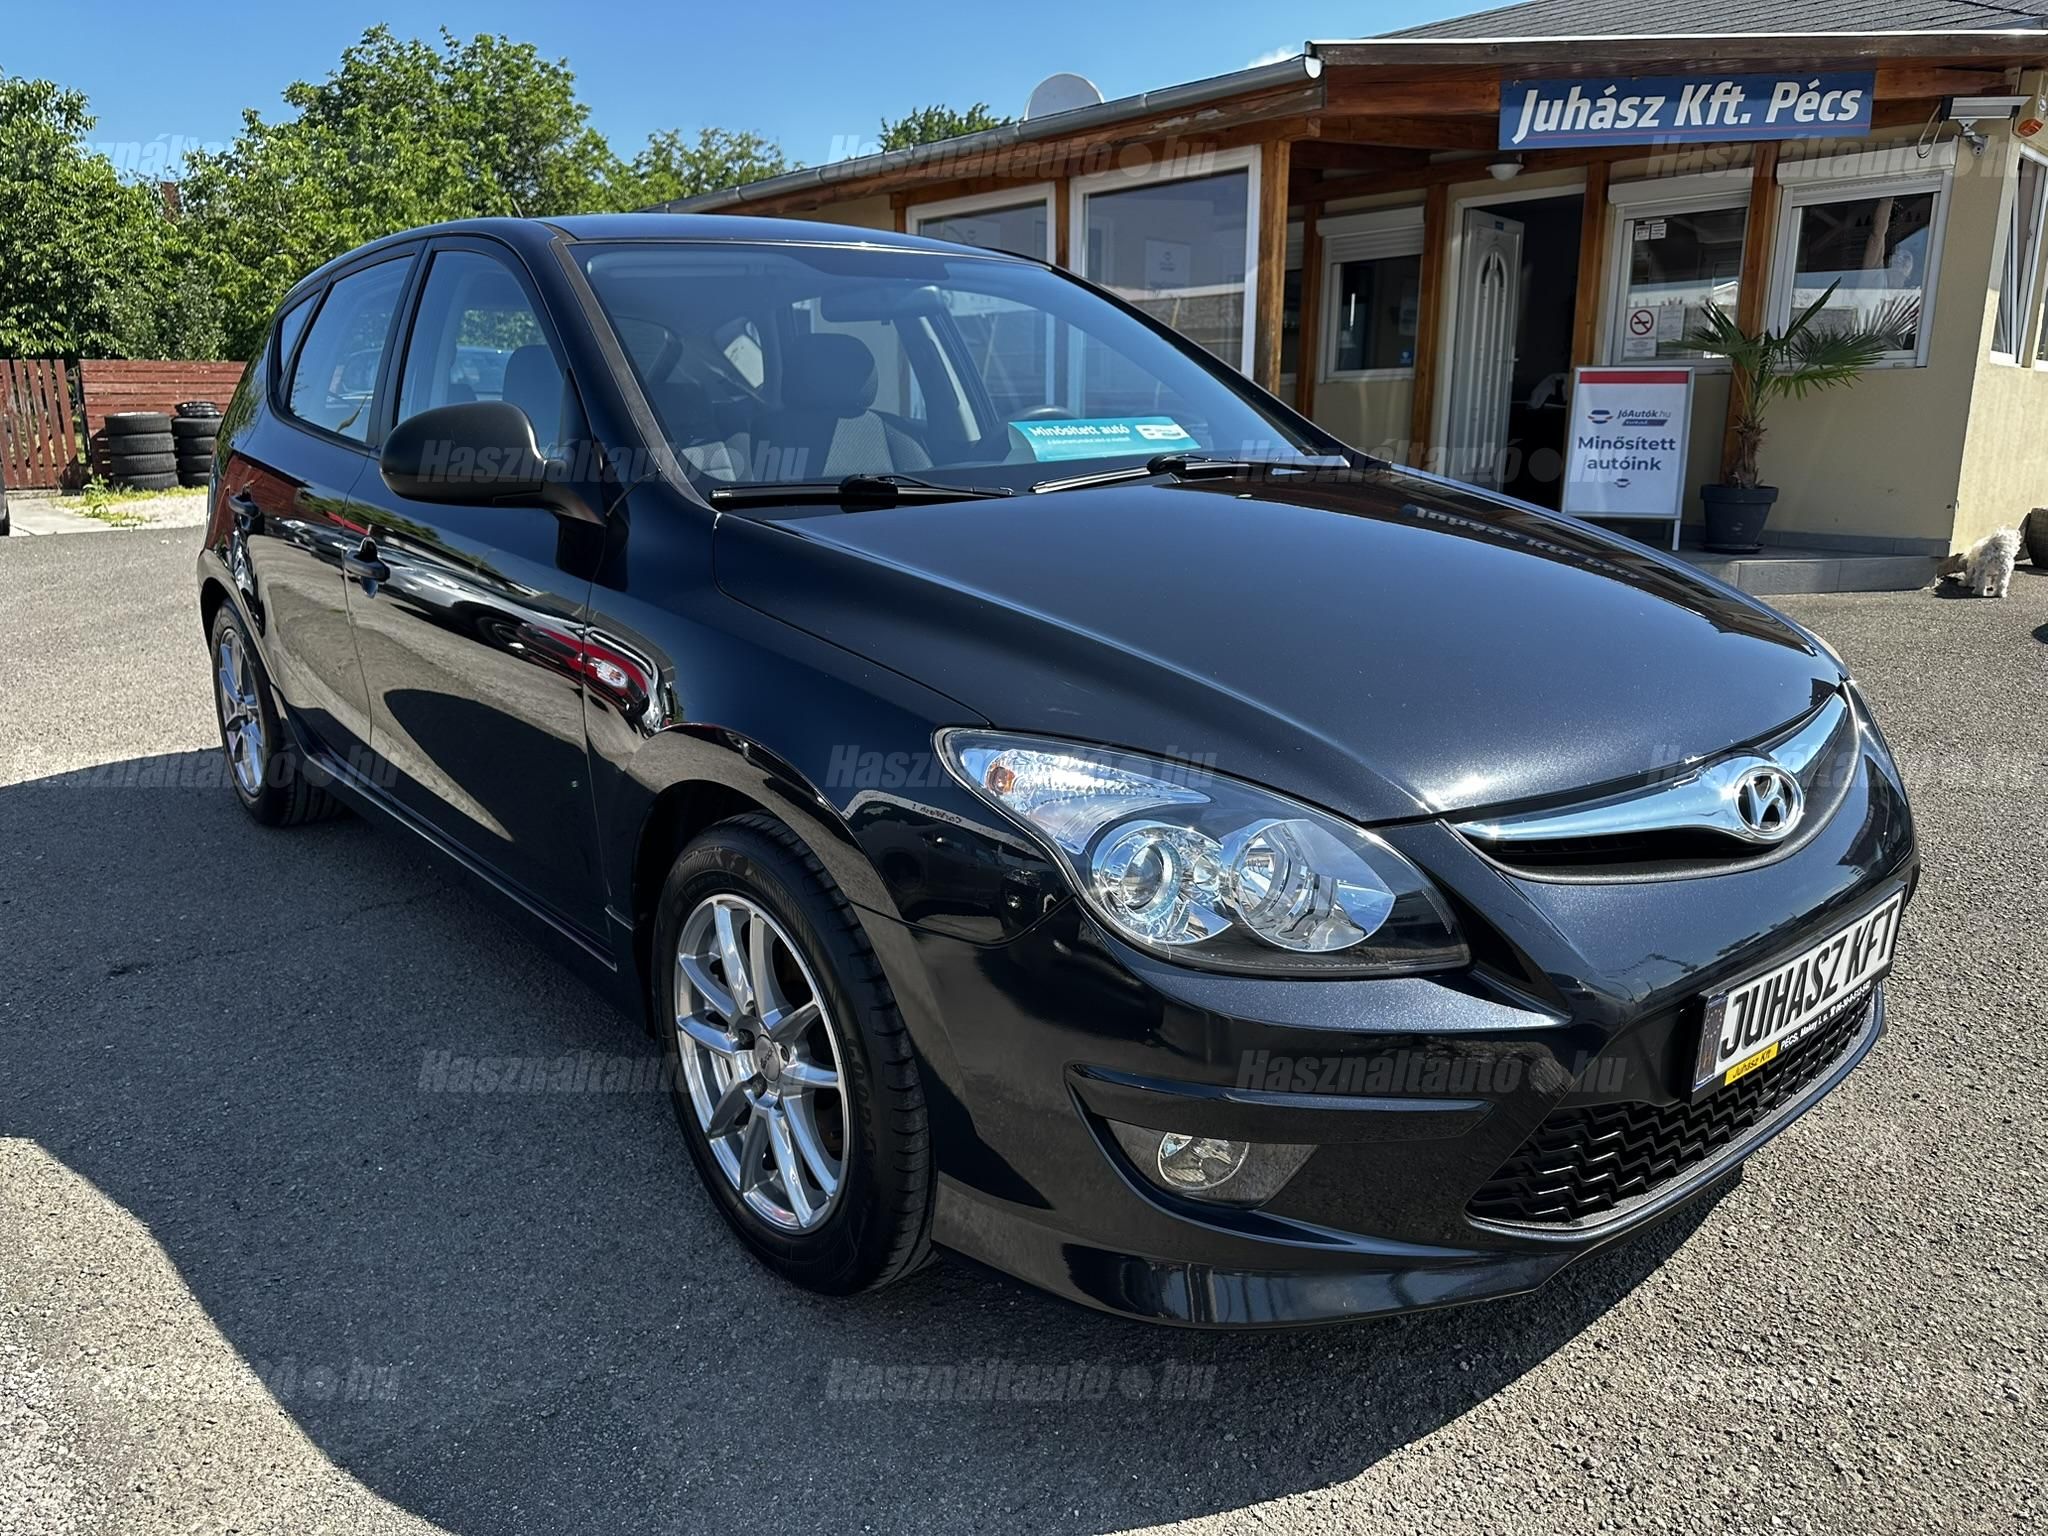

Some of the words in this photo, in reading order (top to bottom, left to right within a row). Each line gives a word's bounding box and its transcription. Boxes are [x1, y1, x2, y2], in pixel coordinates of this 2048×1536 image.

[1511, 84, 1666, 145] Juhász
[1673, 80, 1753, 127] Kft.
[1764, 78, 1864, 123] Pécs
[1577, 435, 1676, 451] Minősített
[1586, 456, 1662, 471] autóink
[1719, 934, 1849, 1063] JUHASZ
[1844, 898, 1899, 987] KFT
